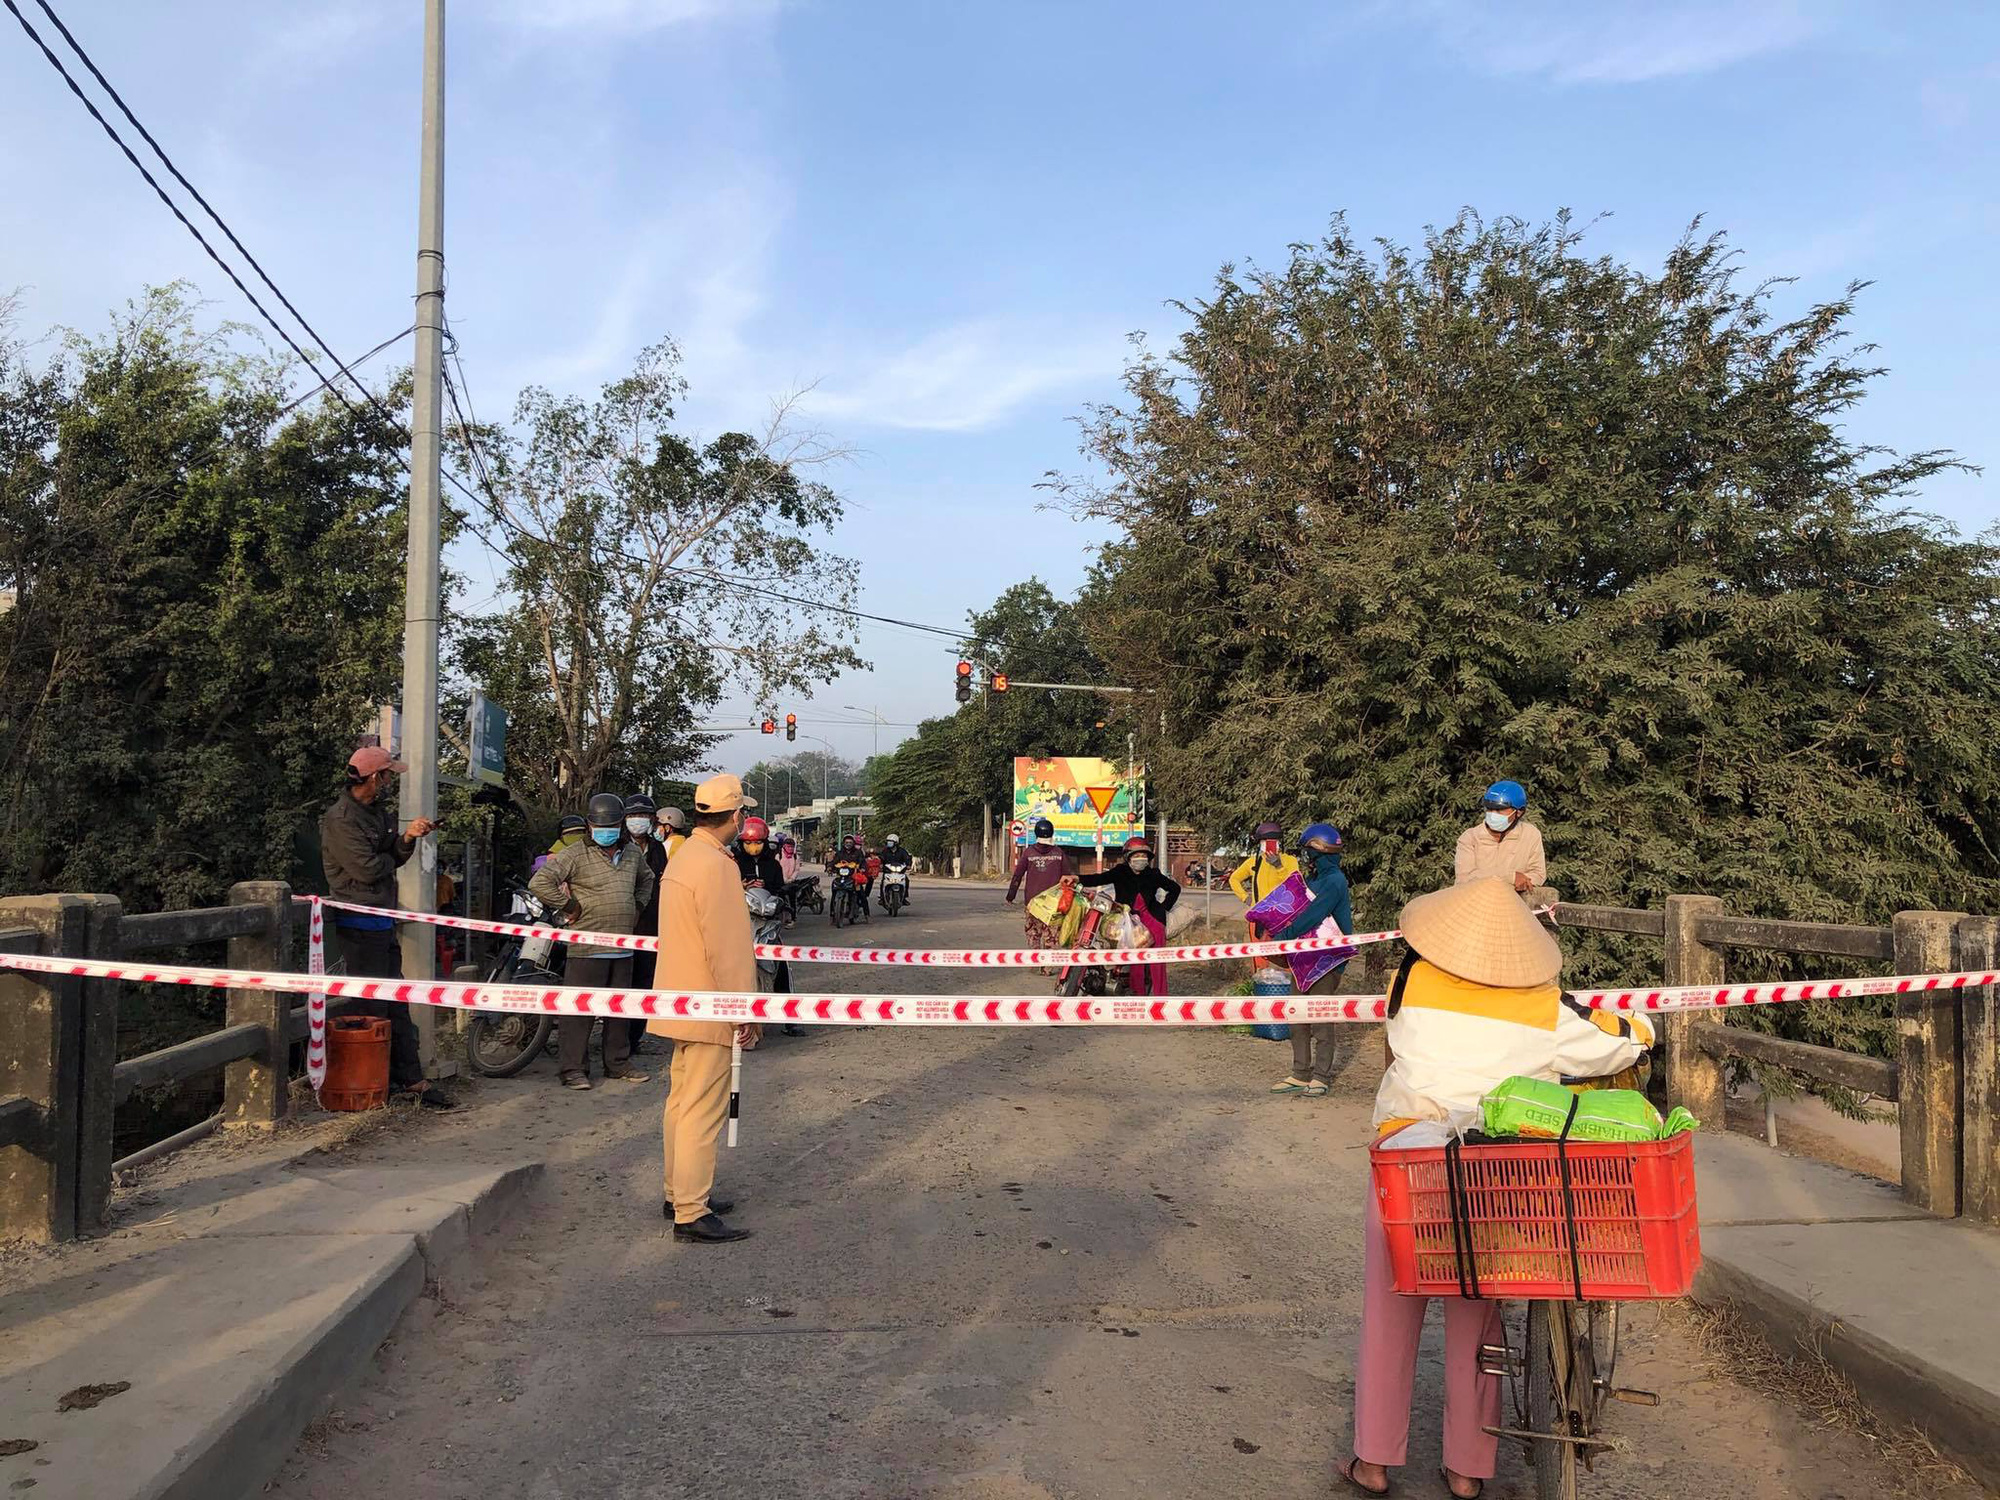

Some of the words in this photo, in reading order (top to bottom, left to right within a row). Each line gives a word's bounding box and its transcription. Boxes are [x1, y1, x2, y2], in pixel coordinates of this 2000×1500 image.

[996, 677, 1007, 690] 15
[1525, 1109, 1562, 1126] SEED
[1570, 1124, 1628, 1142] THAIBIN
